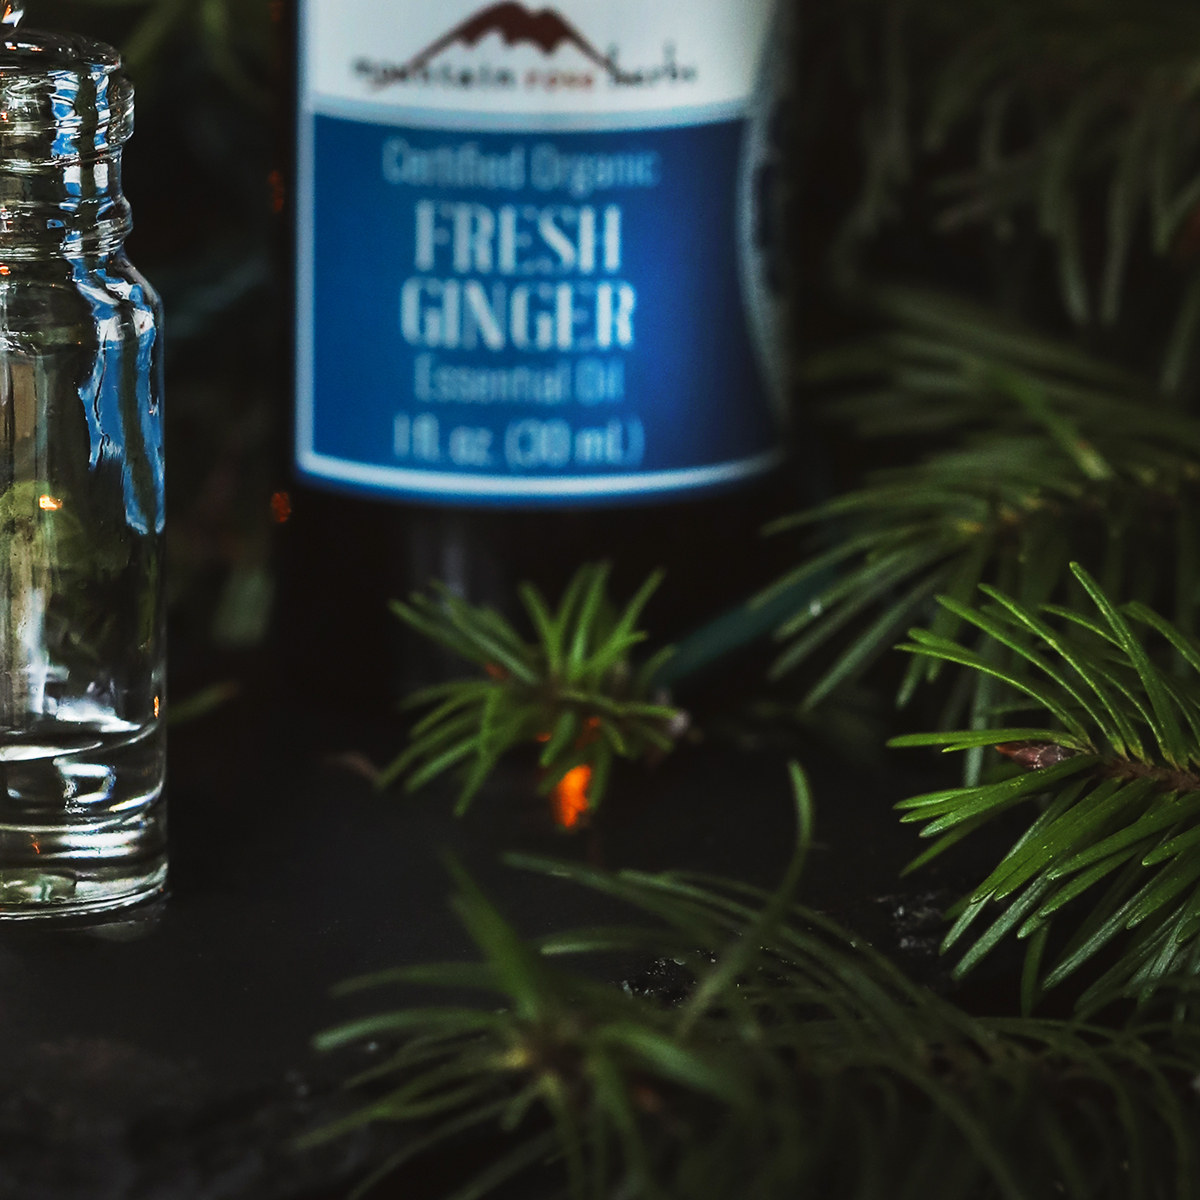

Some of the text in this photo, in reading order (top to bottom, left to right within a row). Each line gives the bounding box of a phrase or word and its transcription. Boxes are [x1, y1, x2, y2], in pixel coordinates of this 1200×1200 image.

[414, 200, 623, 275] FRESH
[401, 277, 637, 351] GINGER
[574, 356, 625, 406] Oil
